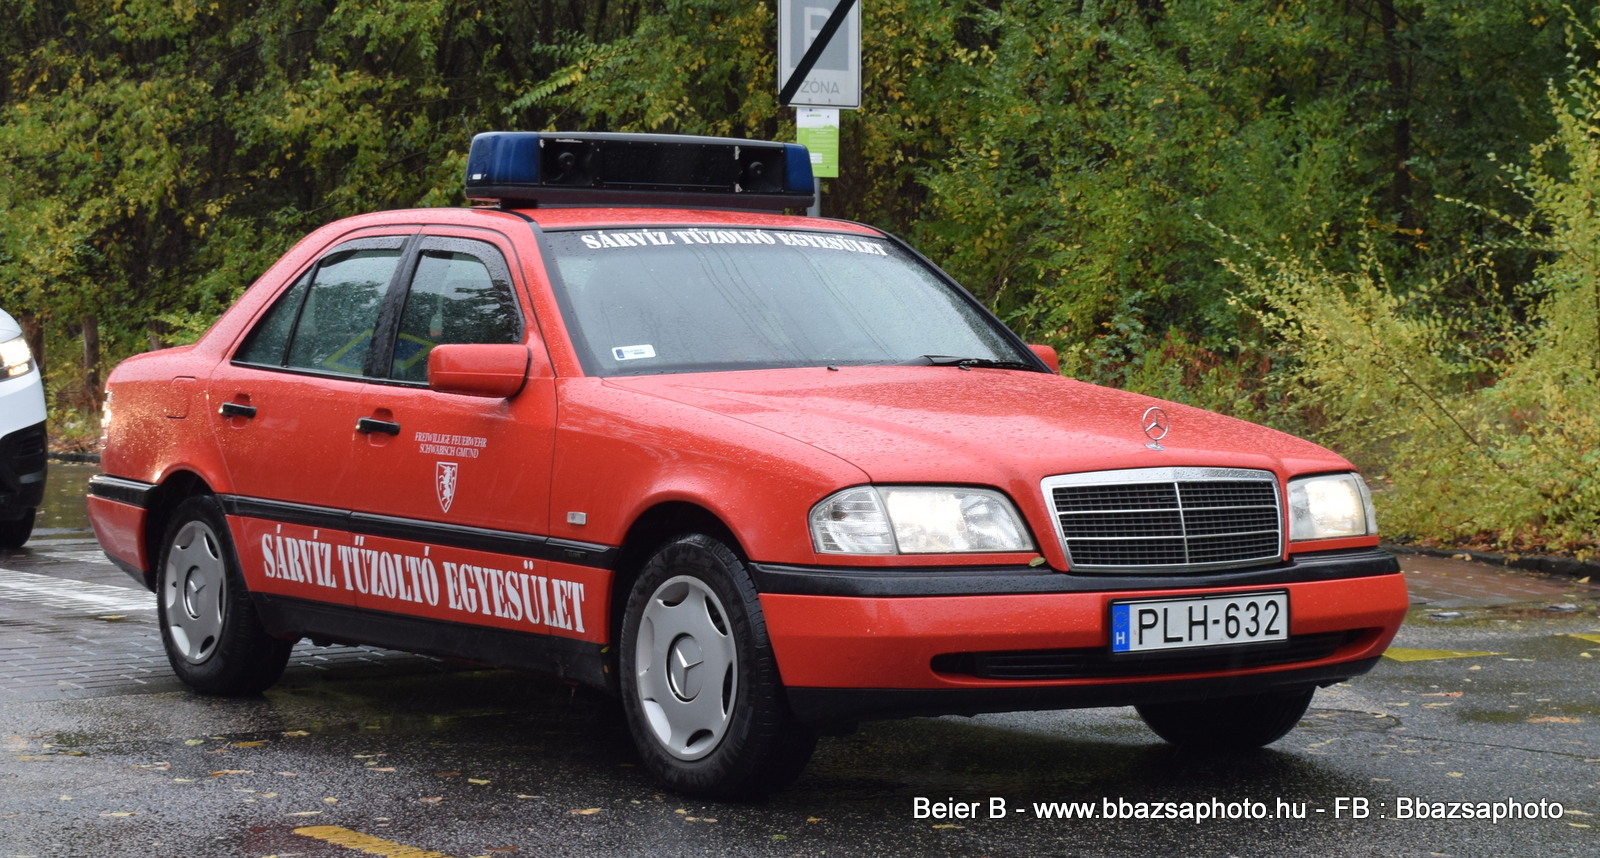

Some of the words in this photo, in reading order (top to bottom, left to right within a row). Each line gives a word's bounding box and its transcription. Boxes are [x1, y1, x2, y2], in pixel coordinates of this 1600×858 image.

[800, 78, 840, 94] ZÓNA
[580, 229, 675, 249] SÁRVÍZ
[775, 232, 888, 256] EGYESÜLET
[415, 432, 451, 444] FREIWILLIGE
[451, 435, 487, 448] FEUERWEHR
[262, 524, 337, 588] SÁRVÍZ
[338, 536, 439, 606] TŰZOLTÓ
[443, 560, 585, 633] EGYESÜLET
[1138, 600, 1280, 645] PLH-632
[1115, 631, 1126, 645] H
